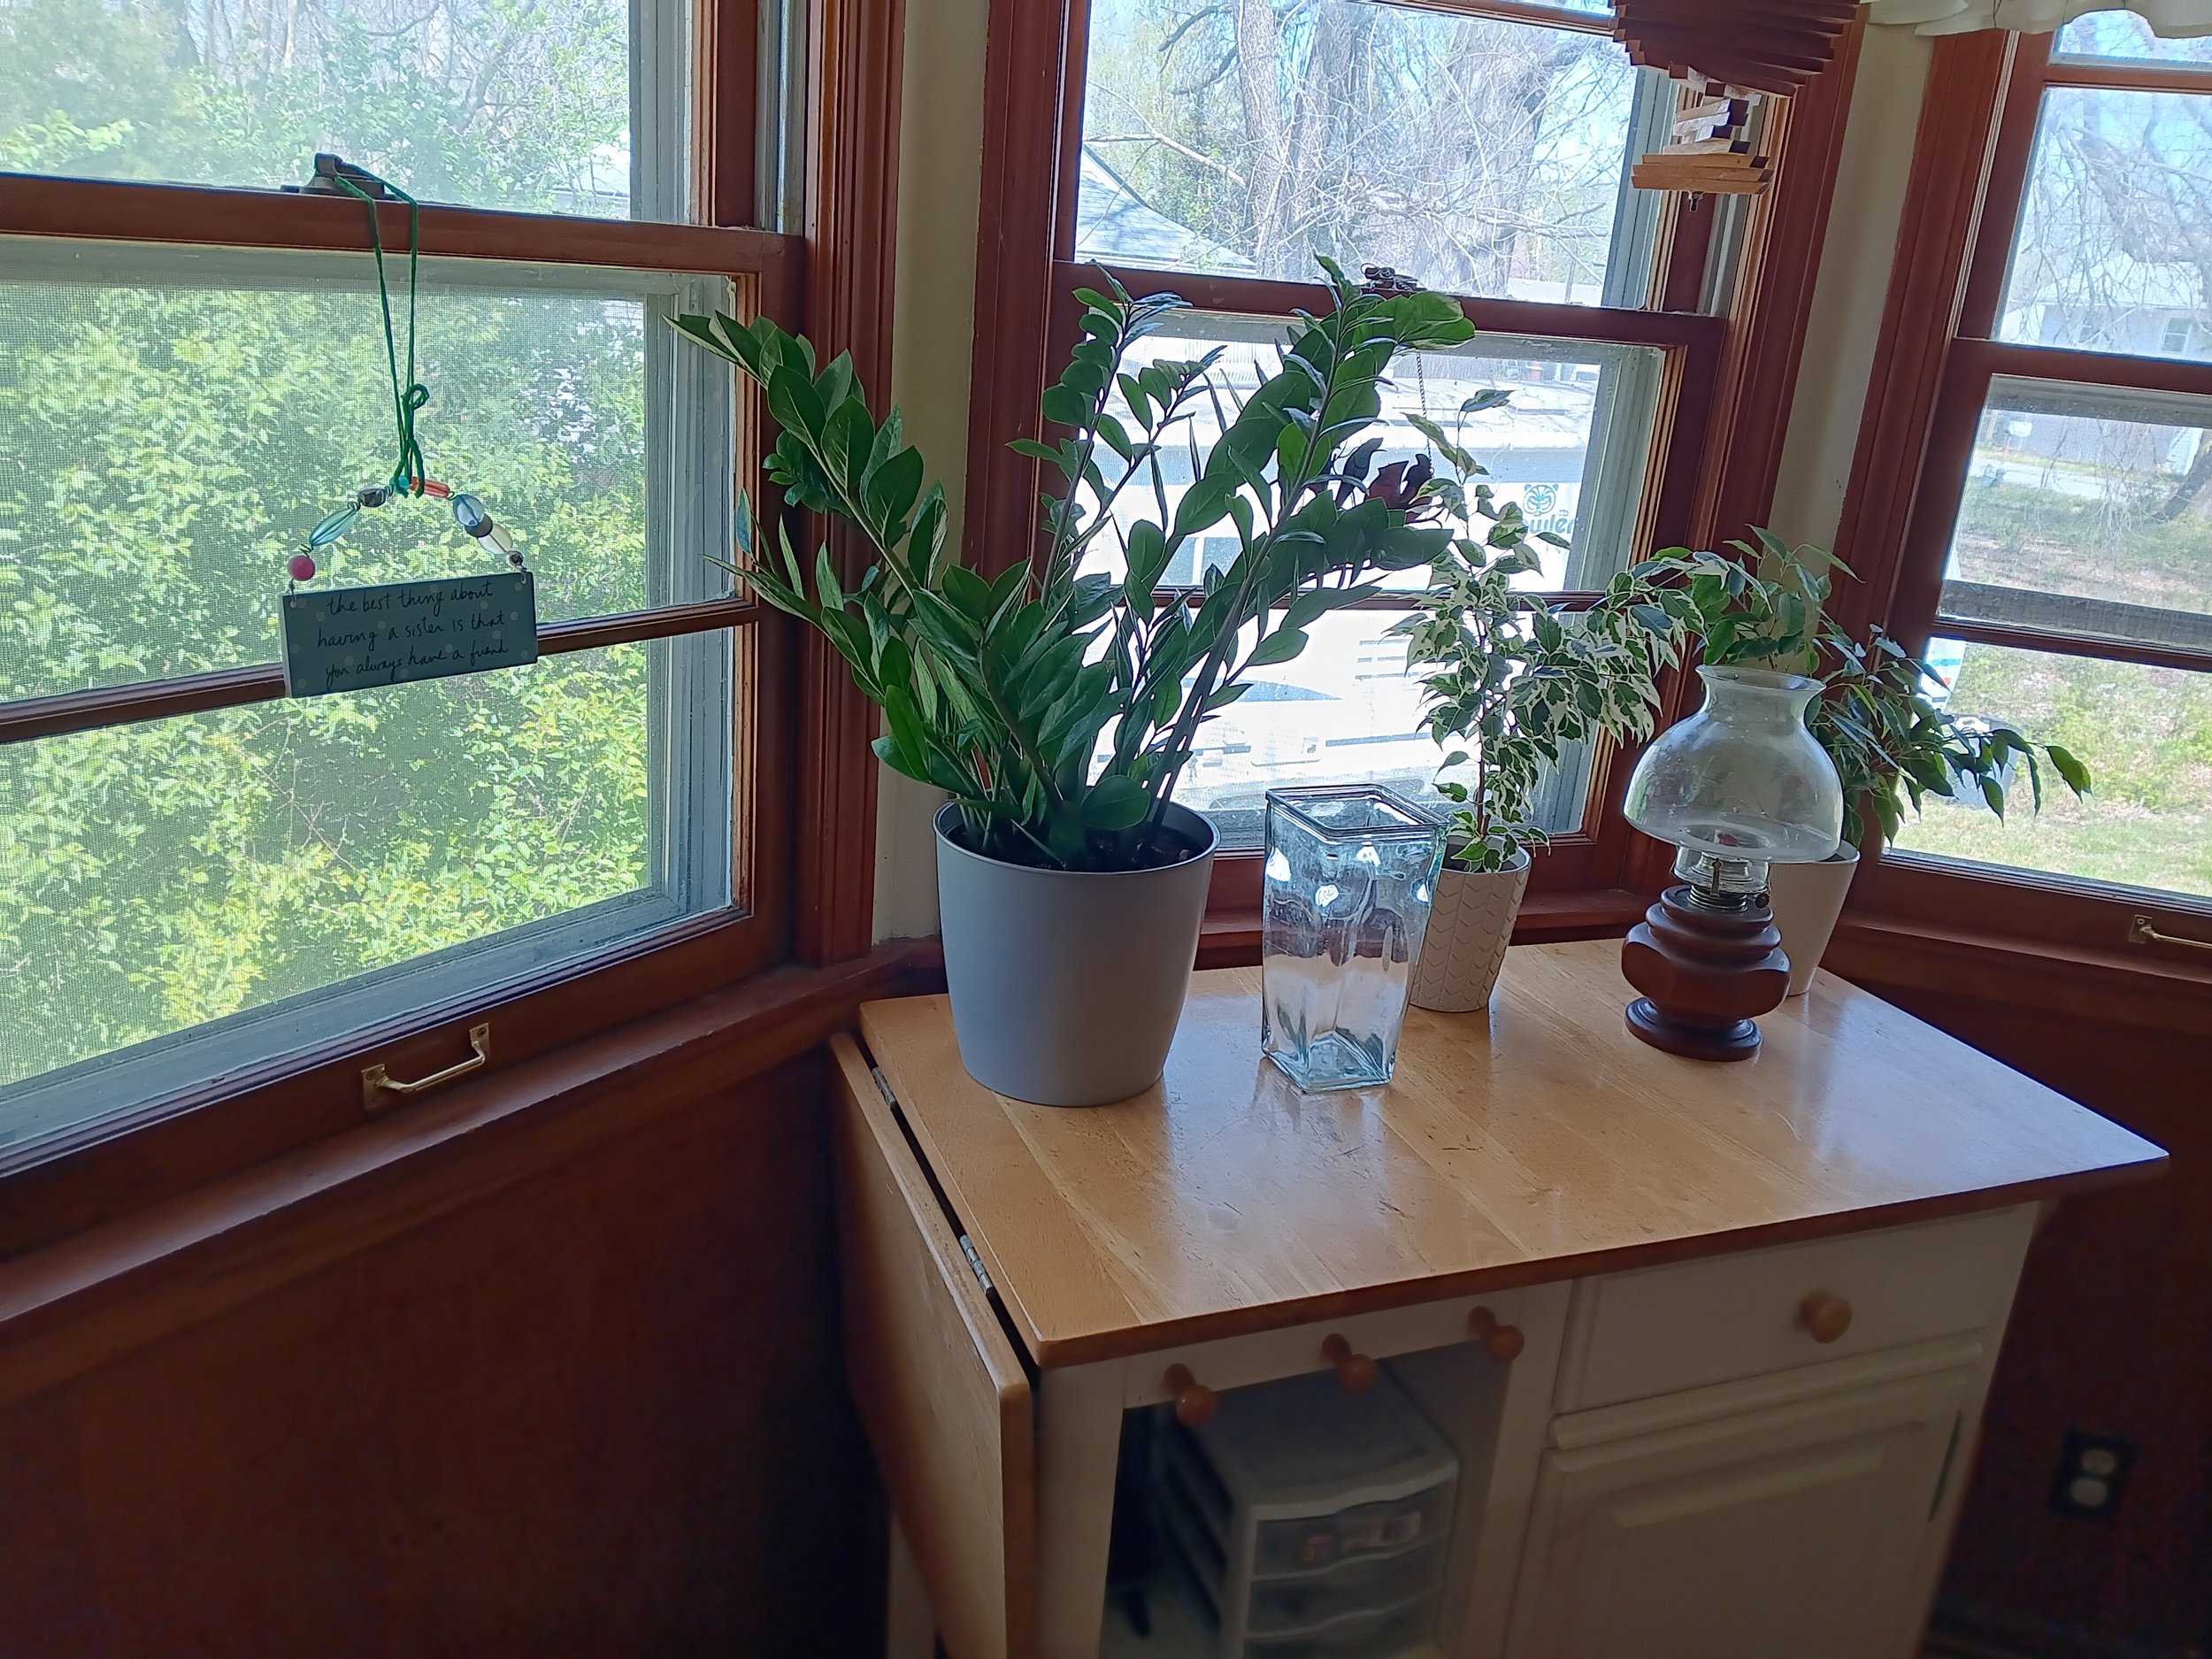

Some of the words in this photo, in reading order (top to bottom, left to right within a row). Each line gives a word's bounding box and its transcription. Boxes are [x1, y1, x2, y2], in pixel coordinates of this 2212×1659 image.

[326, 594, 357, 616] the
[363, 591, 391, 612] best
[397, 588, 444, 618] thing
[450, 580, 494, 601] about
[317, 628, 379, 652] having
[388, 626, 399, 641] a
[404, 616, 444, 638] sister
[452, 618, 464, 632] is
[471, 611, 505, 631] that
[326, 663, 350, 691] you
[357, 655, 403, 682] always
[408, 644, 448, 666] have
[452, 649, 465, 660] a
[470, 638, 510, 667] friend
